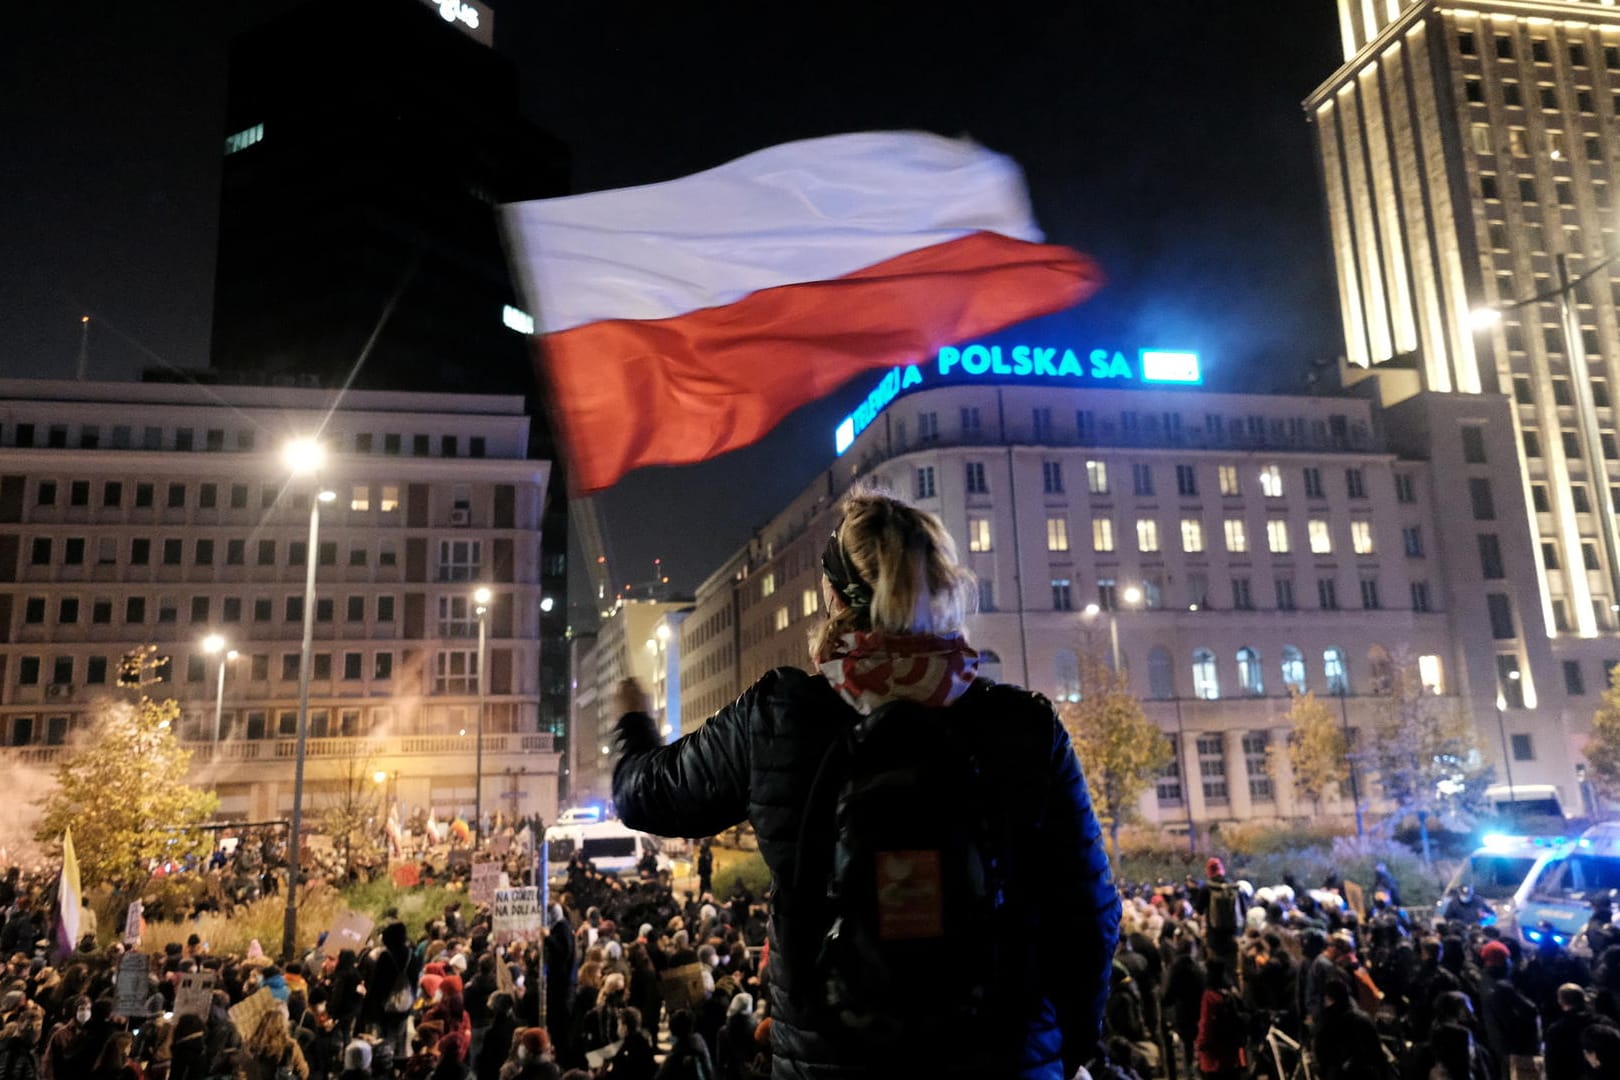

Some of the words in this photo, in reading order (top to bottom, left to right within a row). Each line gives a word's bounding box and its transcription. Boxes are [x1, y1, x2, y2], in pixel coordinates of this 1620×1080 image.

[938, 344, 1083, 377] POLSKA
[1089, 348, 1133, 379] SA
[496, 891, 509, 902] NA
[495, 904, 508, 916] NA
